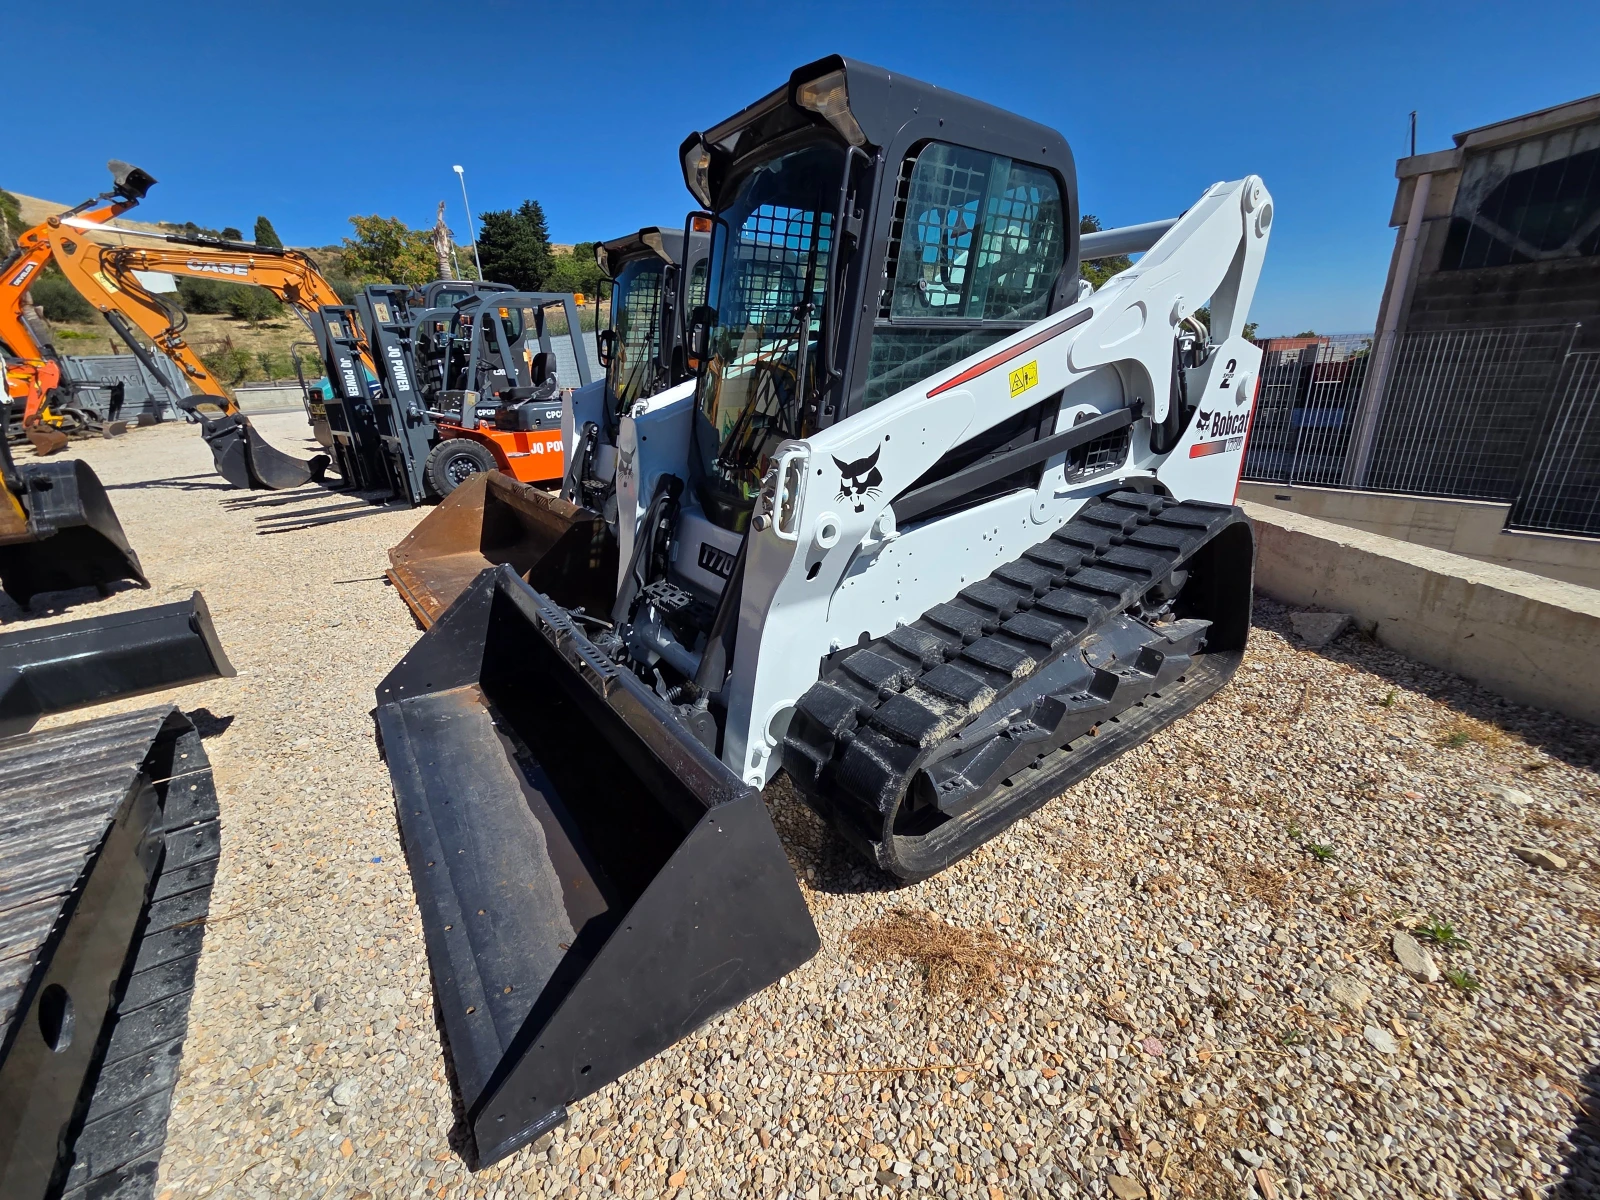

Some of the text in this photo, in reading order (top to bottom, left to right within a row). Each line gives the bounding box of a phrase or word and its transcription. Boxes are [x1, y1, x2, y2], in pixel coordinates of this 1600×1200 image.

[186, 258, 249, 276] CASE
[340, 357, 360, 396] JQ POWER
[388, 346, 410, 391] JQ POWER
[1220, 359, 1237, 389] 2
[546, 410, 563, 419] CPC
[1211, 410, 1250, 438] Bobcat
[530, 442, 544, 454] JQ
[702, 545, 736, 576] T770
